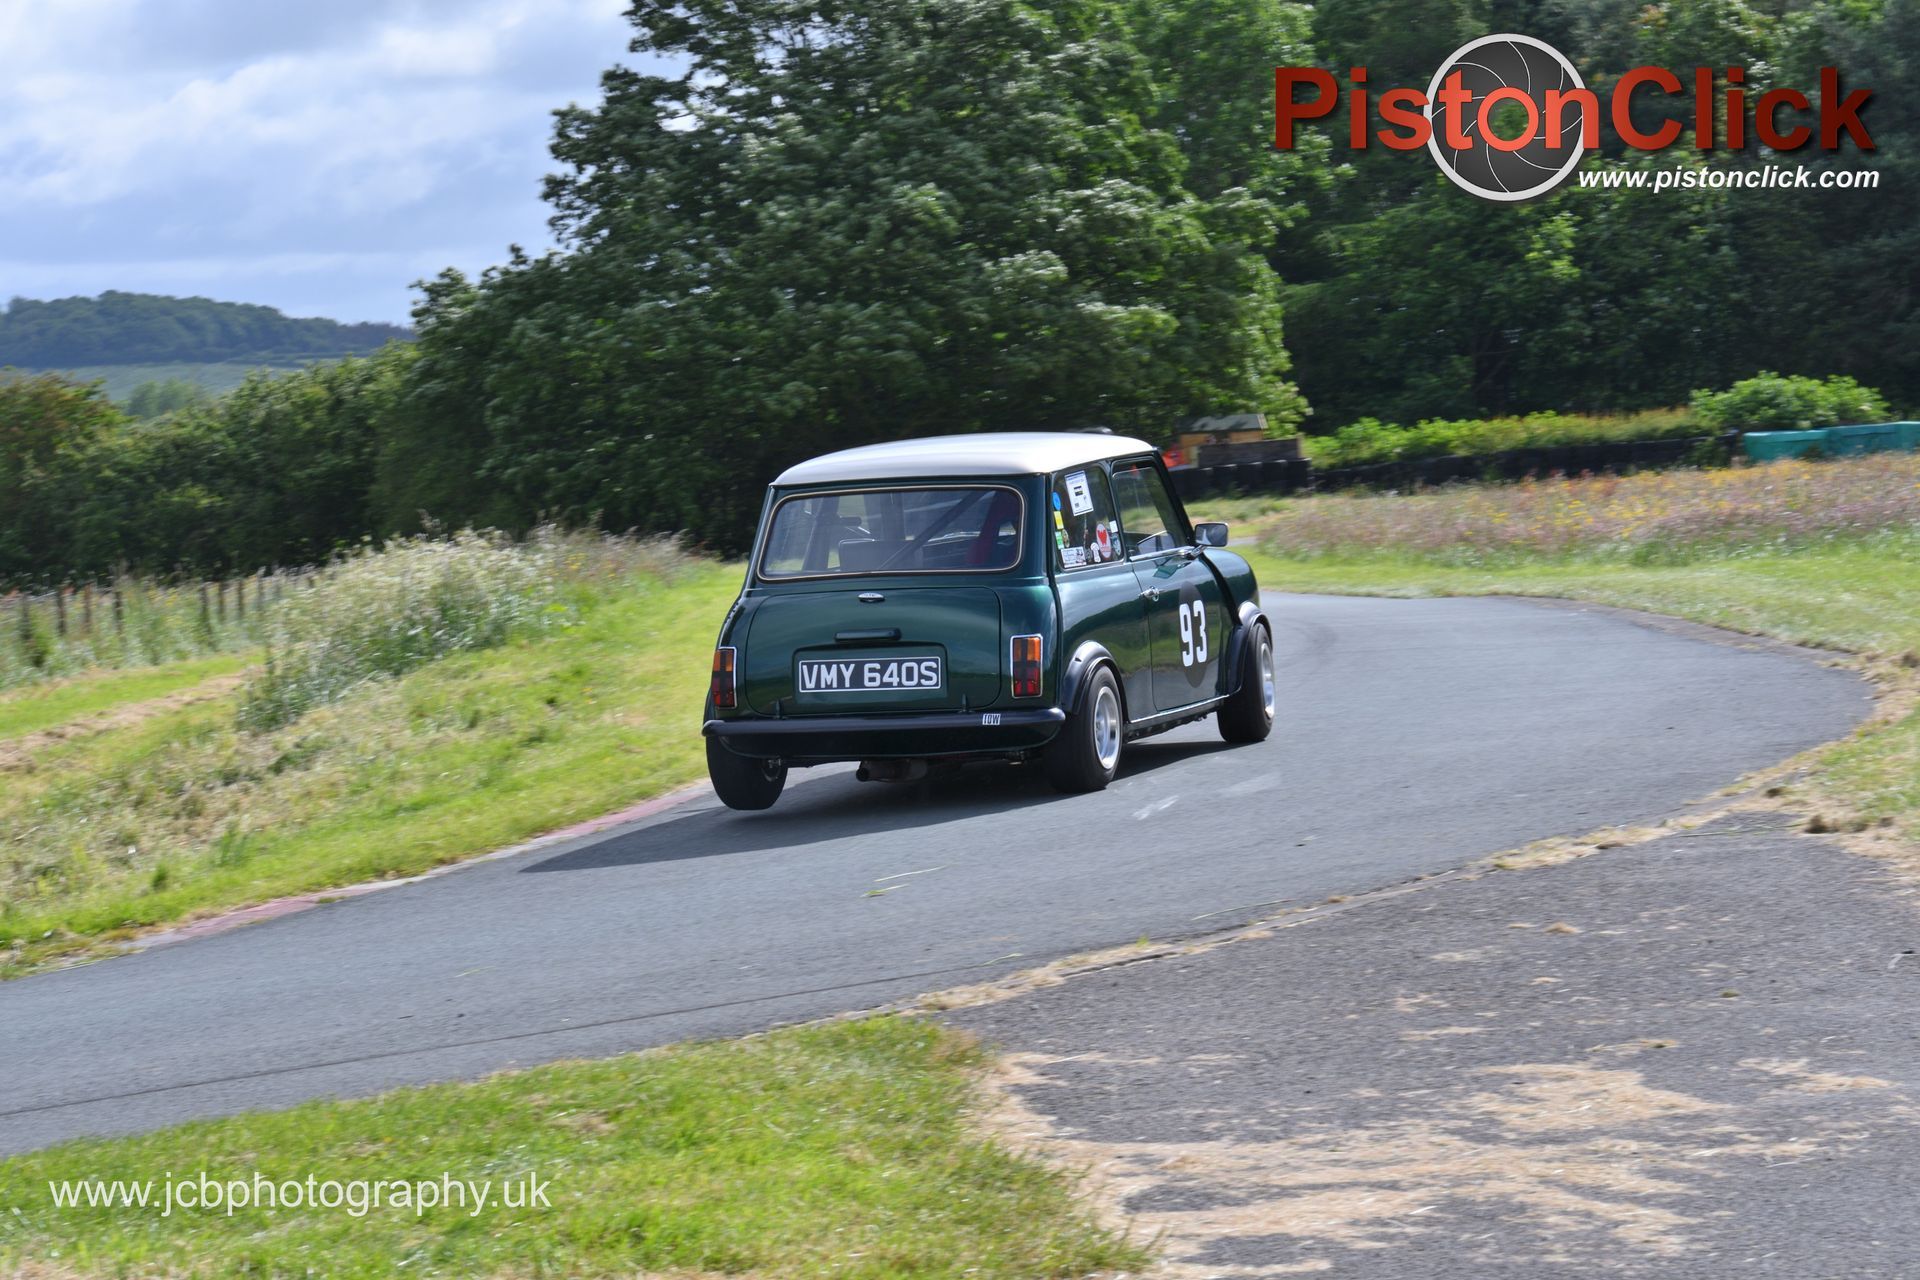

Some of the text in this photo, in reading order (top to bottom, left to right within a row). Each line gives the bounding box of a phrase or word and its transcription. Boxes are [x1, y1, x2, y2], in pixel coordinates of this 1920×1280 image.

[1179, 600, 1207, 667] 93
[802, 661, 938, 689] VMY 640S
